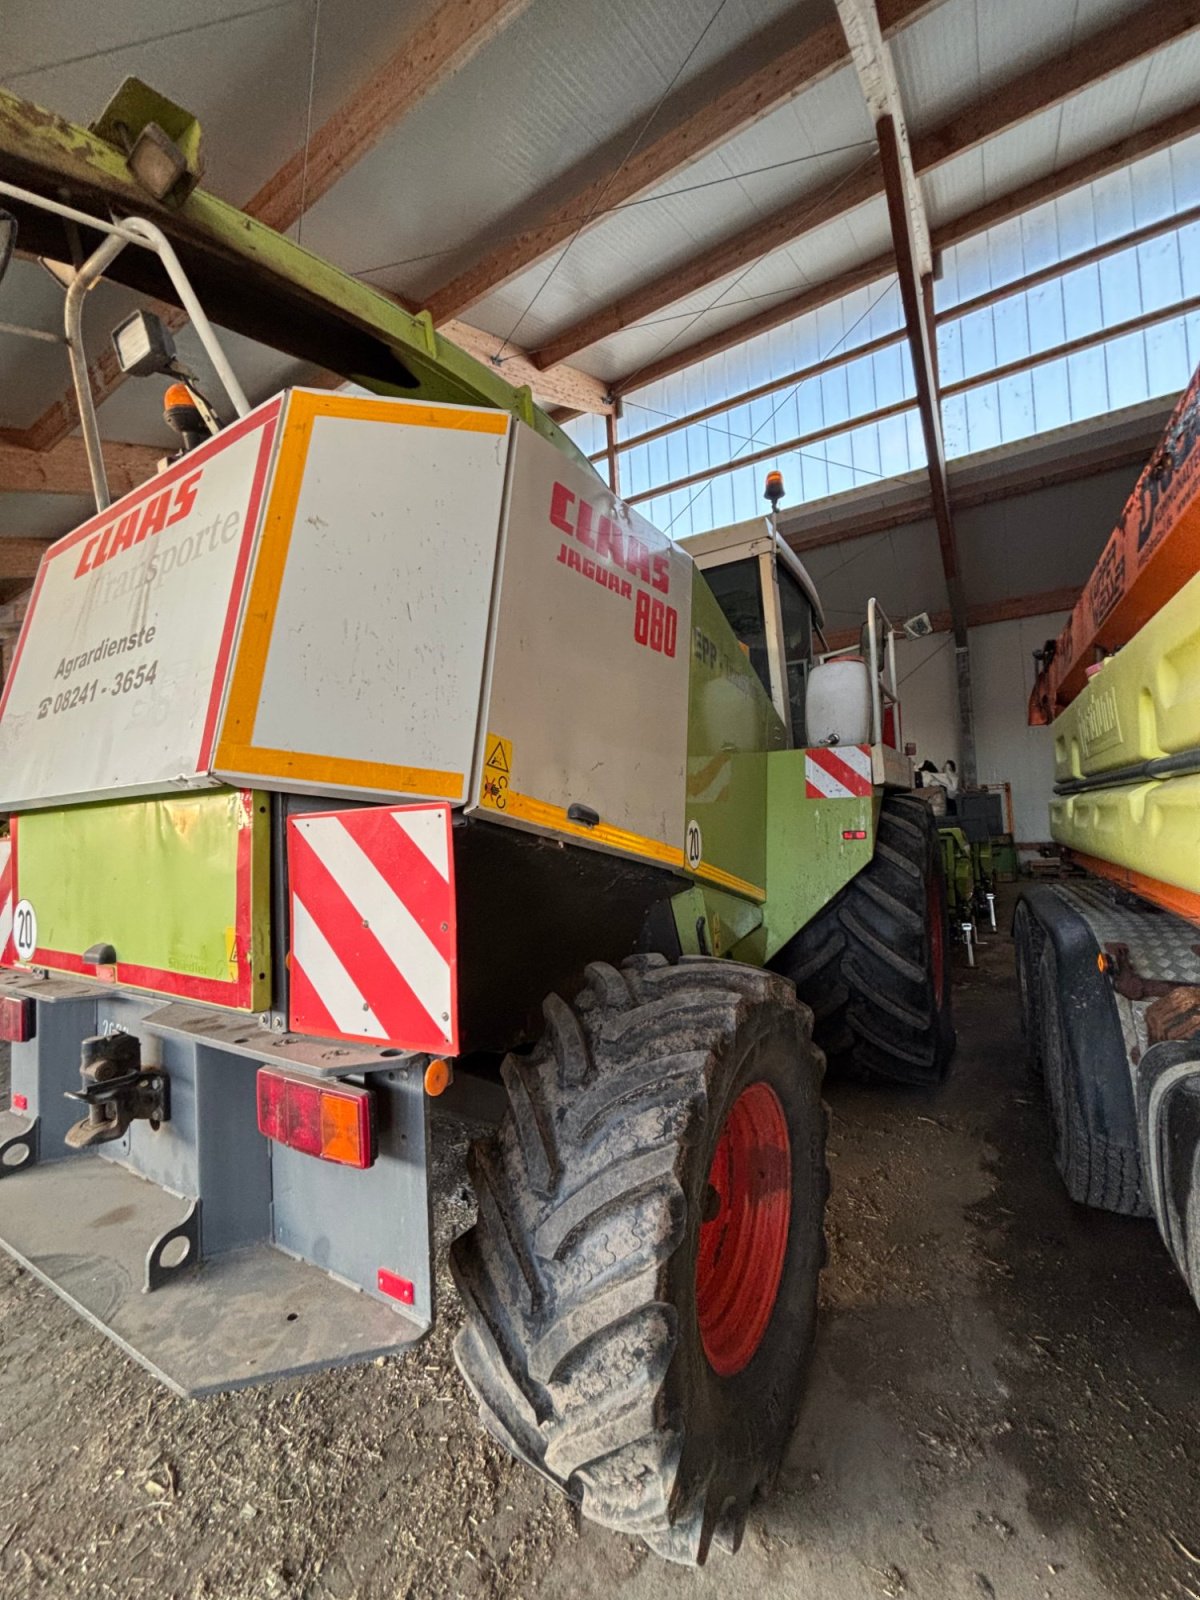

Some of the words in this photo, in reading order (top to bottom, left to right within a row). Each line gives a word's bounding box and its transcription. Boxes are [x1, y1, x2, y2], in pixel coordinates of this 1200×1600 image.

[74, 469, 204, 580] CLAAS
[549, 481, 670, 594] CLAAS
[556, 543, 632, 600] JAGUAR
[634, 589, 678, 658] 880
[54, 625, 156, 680] Agrardienste
[53, 679, 98, 714] 08241
[111, 660, 158, 696] 3654
[689, 827, 699, 861] 20
[18, 909, 32, 949] 20
